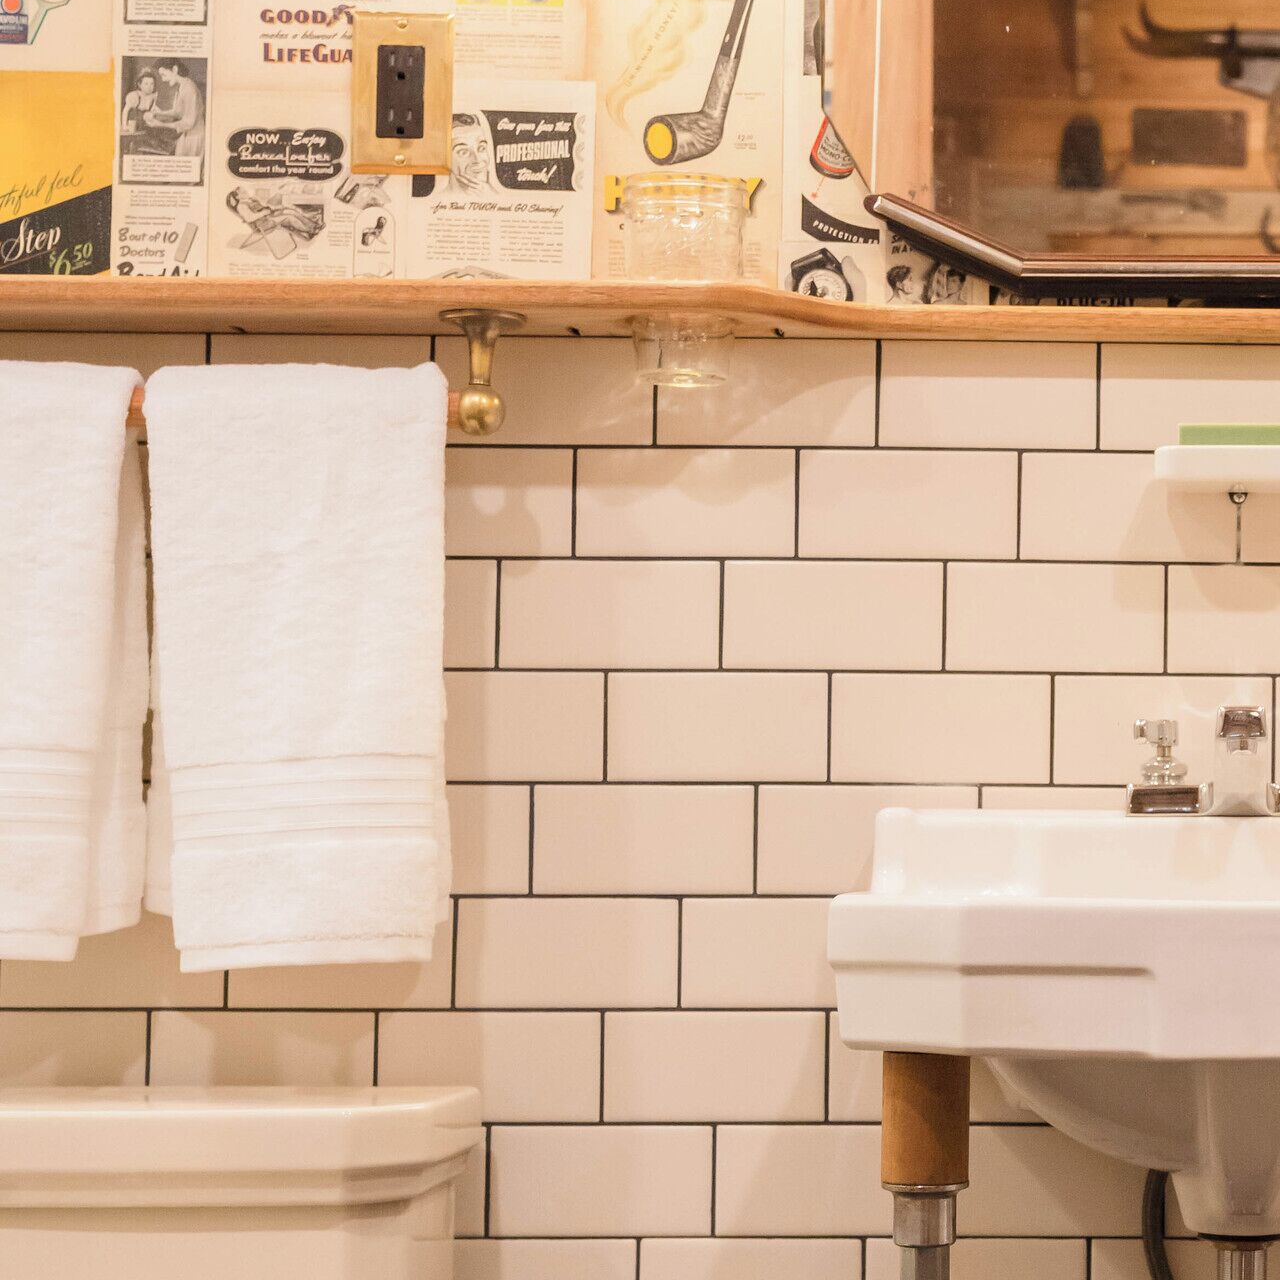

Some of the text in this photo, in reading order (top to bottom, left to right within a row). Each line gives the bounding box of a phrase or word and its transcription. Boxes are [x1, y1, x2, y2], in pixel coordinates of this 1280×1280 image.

[259, 31, 338, 40] makes blowout
[292, 131, 327, 148] Enjoy
[496, 139, 570, 164] PROFESSIONAL
[239, 164, 334, 176] comfort the year round
[45, 164, 83, 205] feel
[468, 203, 497, 211] TOUCH
[118, 227, 179, 244] 8 out of 10
[812, 219, 864, 243] PROTECTION
[1, 218, 62, 264] Step
[120, 246, 166, 258] Doctors
